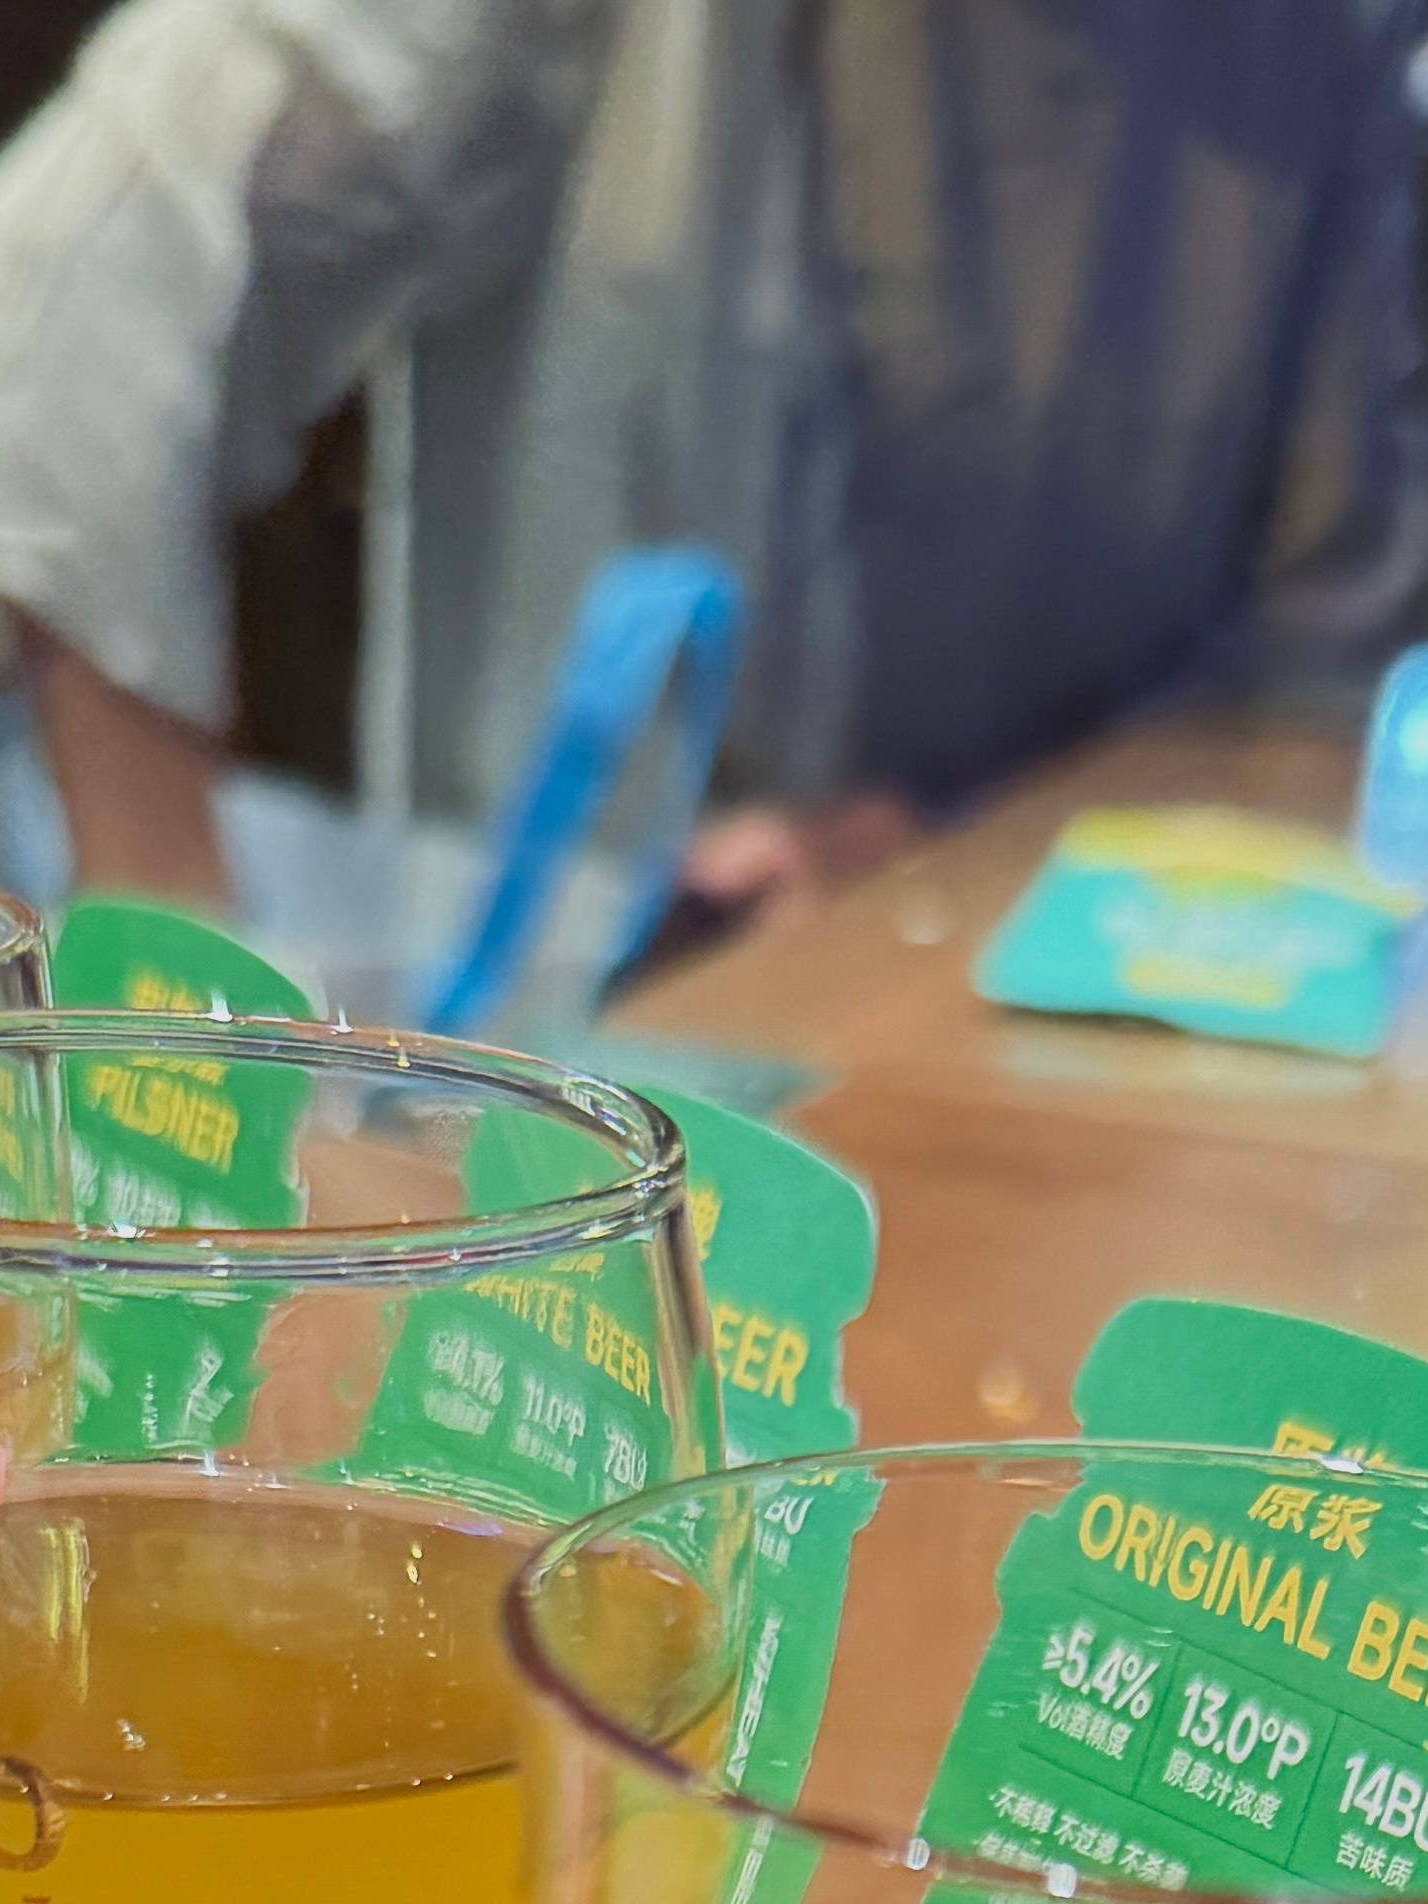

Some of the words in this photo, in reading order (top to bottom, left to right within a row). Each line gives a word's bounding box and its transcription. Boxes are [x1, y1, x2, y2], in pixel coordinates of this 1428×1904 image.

[584, 1301, 651, 1407] BEER
[711, 1303, 808, 1407] EER
[1248, 1483, 1382, 1560] 原浆
[1078, 1493, 1330, 1661] ORIGINAL
[1336, 1834, 1416, 1893] 苦味质
